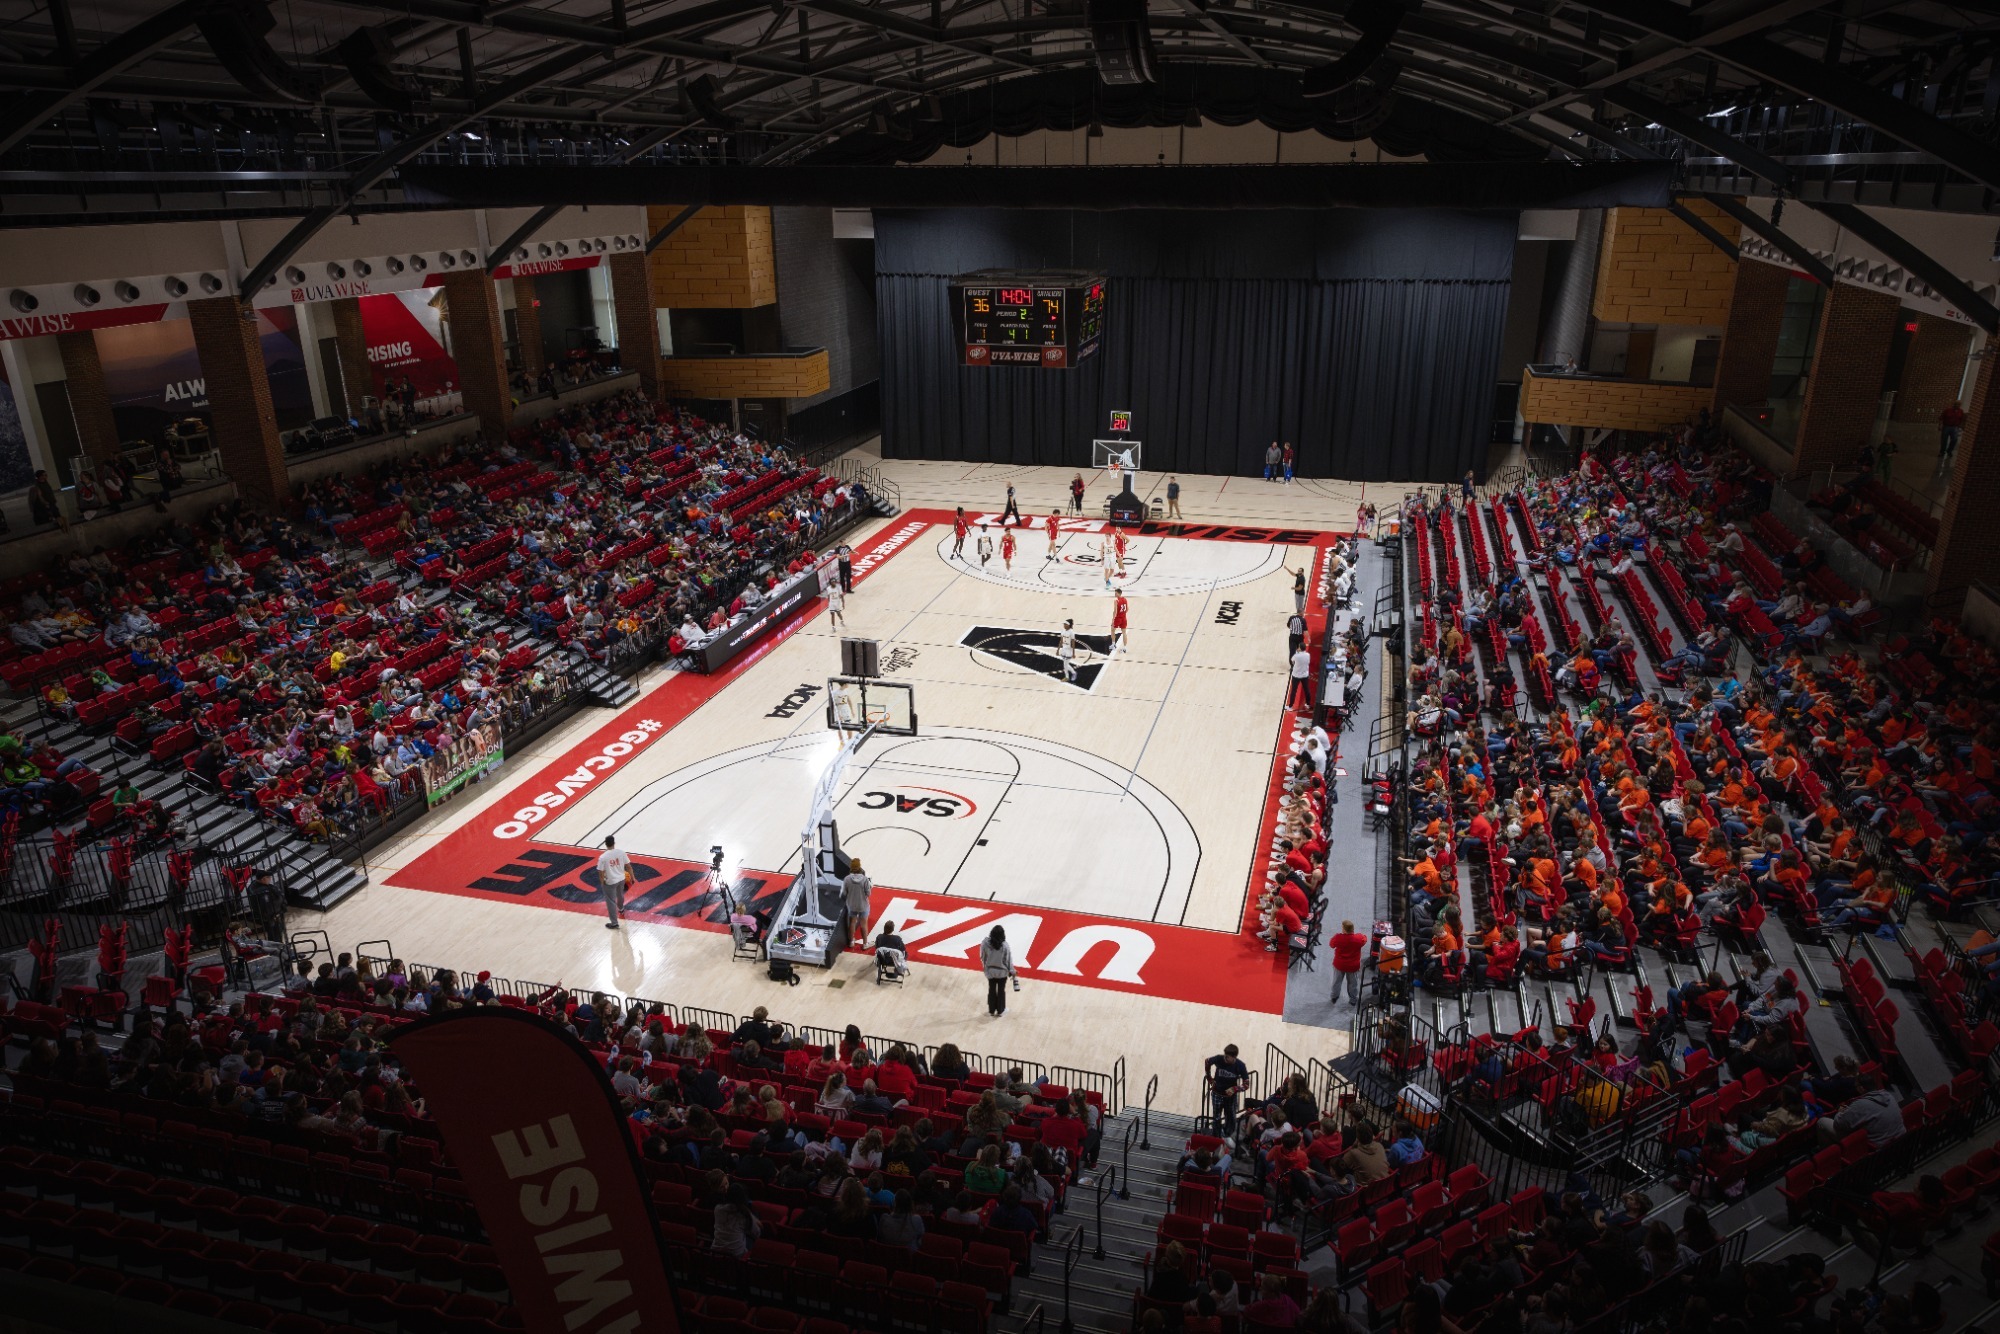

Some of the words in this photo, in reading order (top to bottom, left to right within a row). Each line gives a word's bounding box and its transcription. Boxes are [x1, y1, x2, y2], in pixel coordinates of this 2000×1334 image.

[305, 286, 335, 301] UVA
[335, 281, 371, 297] WISE
[1001, 289, 1031, 304] 14:04
[973, 298, 990, 312] 36
[1042, 299, 1059, 314] 74
[1019, 308, 1027, 320] 2
[10, 313, 75, 337] WISE
[366, 341, 412, 362] RISING
[1139, 521, 1322, 544] WISE
[1074, 554, 1138, 566] SC
[1214, 600, 1244, 626] NCAA
[762, 683, 823, 719] NCAA
[493, 718, 664, 839] #GOCAVSGO
[856, 790, 962, 818] SAC
[854, 897, 1156, 985] UVA
